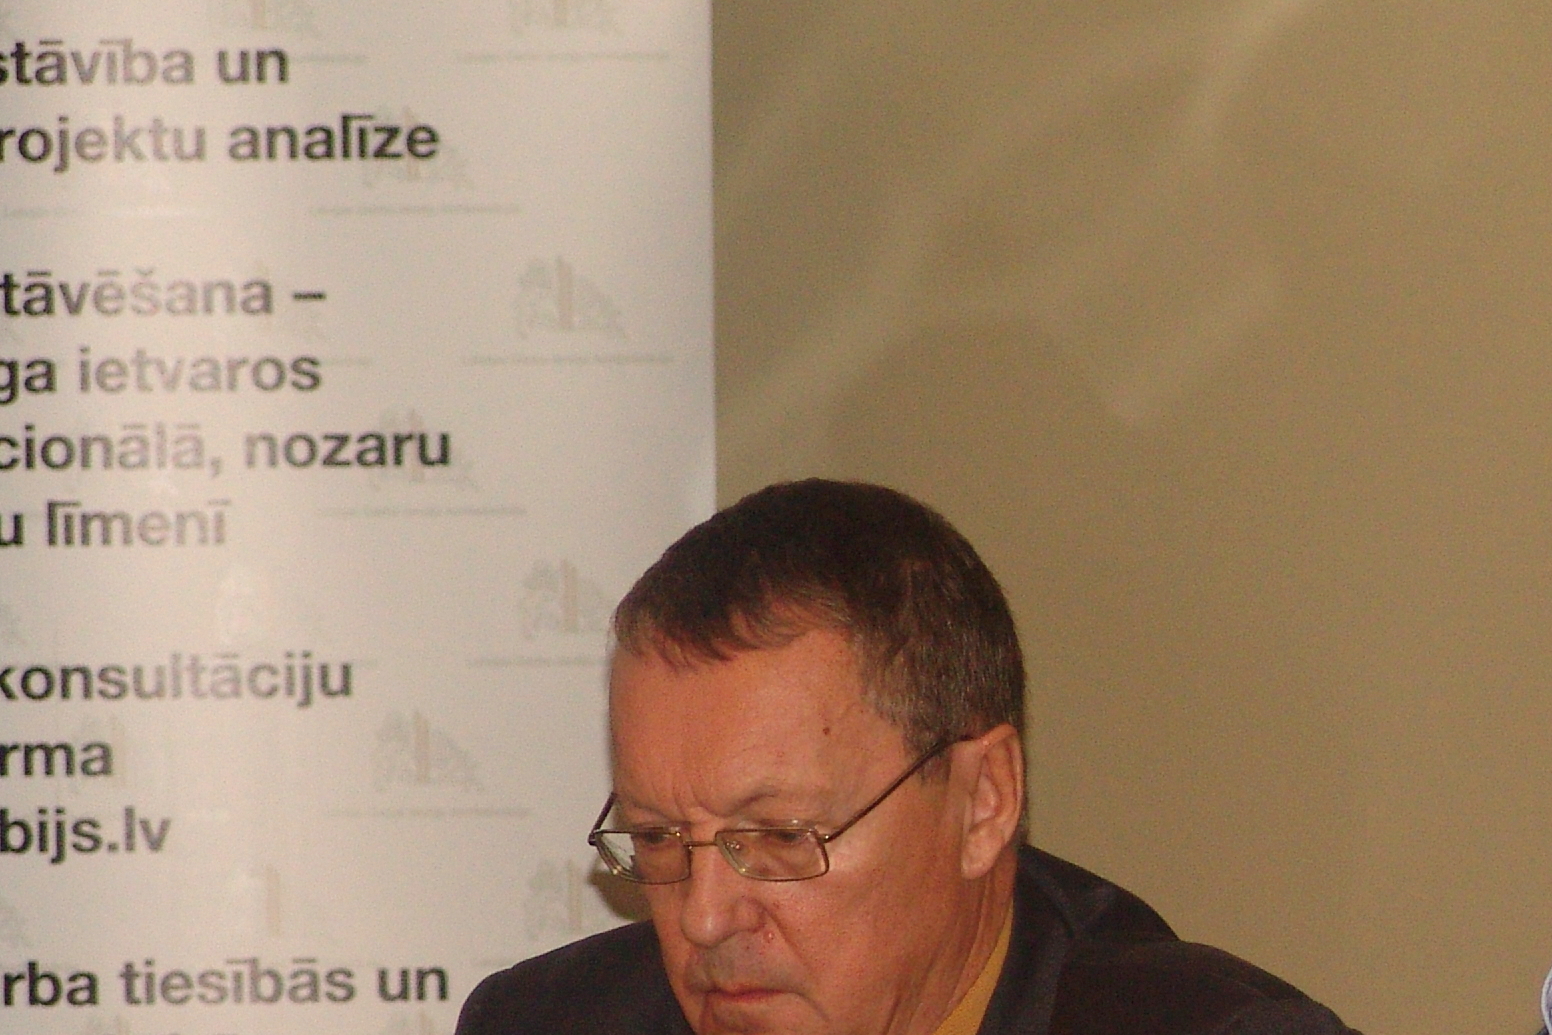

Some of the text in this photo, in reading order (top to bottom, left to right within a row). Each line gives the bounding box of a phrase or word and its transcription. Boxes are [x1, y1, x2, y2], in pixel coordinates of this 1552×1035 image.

[217, 47, 291, 84] un
[228, 113, 440, 161] analīze
[78, 345, 322, 392] ietvaros
[244, 429, 451, 469] nozaru
[46, 499, 232, 547] līmenī
[0, 805, 171, 865] bijs.lv
[4, 957, 449, 1006] rba tiesībās un
